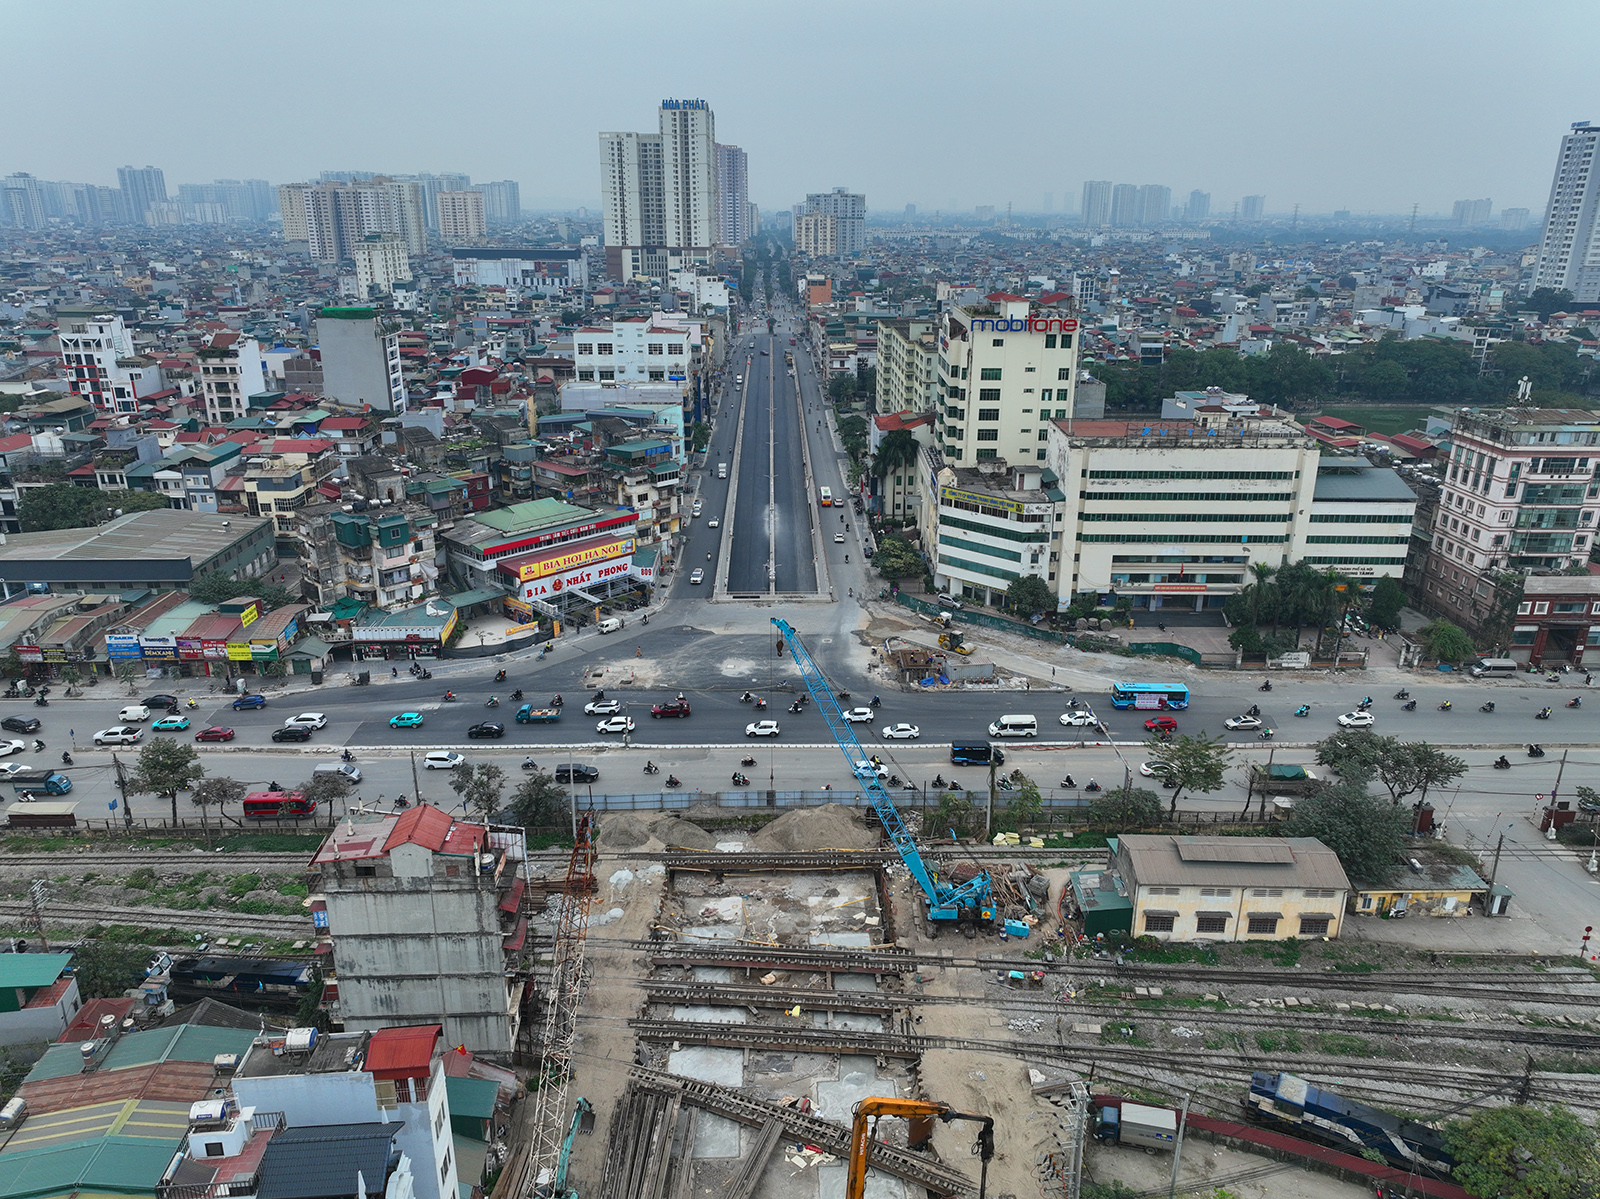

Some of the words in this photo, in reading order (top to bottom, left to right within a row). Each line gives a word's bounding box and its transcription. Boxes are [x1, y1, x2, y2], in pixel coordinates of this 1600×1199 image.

[662, 96, 680, 110] HÒA
[682, 98, 706, 110] PHÁT
[970, 314, 1078, 332] mobifone
[542, 560, 560, 570] BIA
[585, 550, 600, 560] HÀ
[601, 544, 619, 556] NỘI
[526, 586, 547, 598] BIA
[566, 571, 591, 587] NHẤT
[598, 563, 628, 578] PHONG
